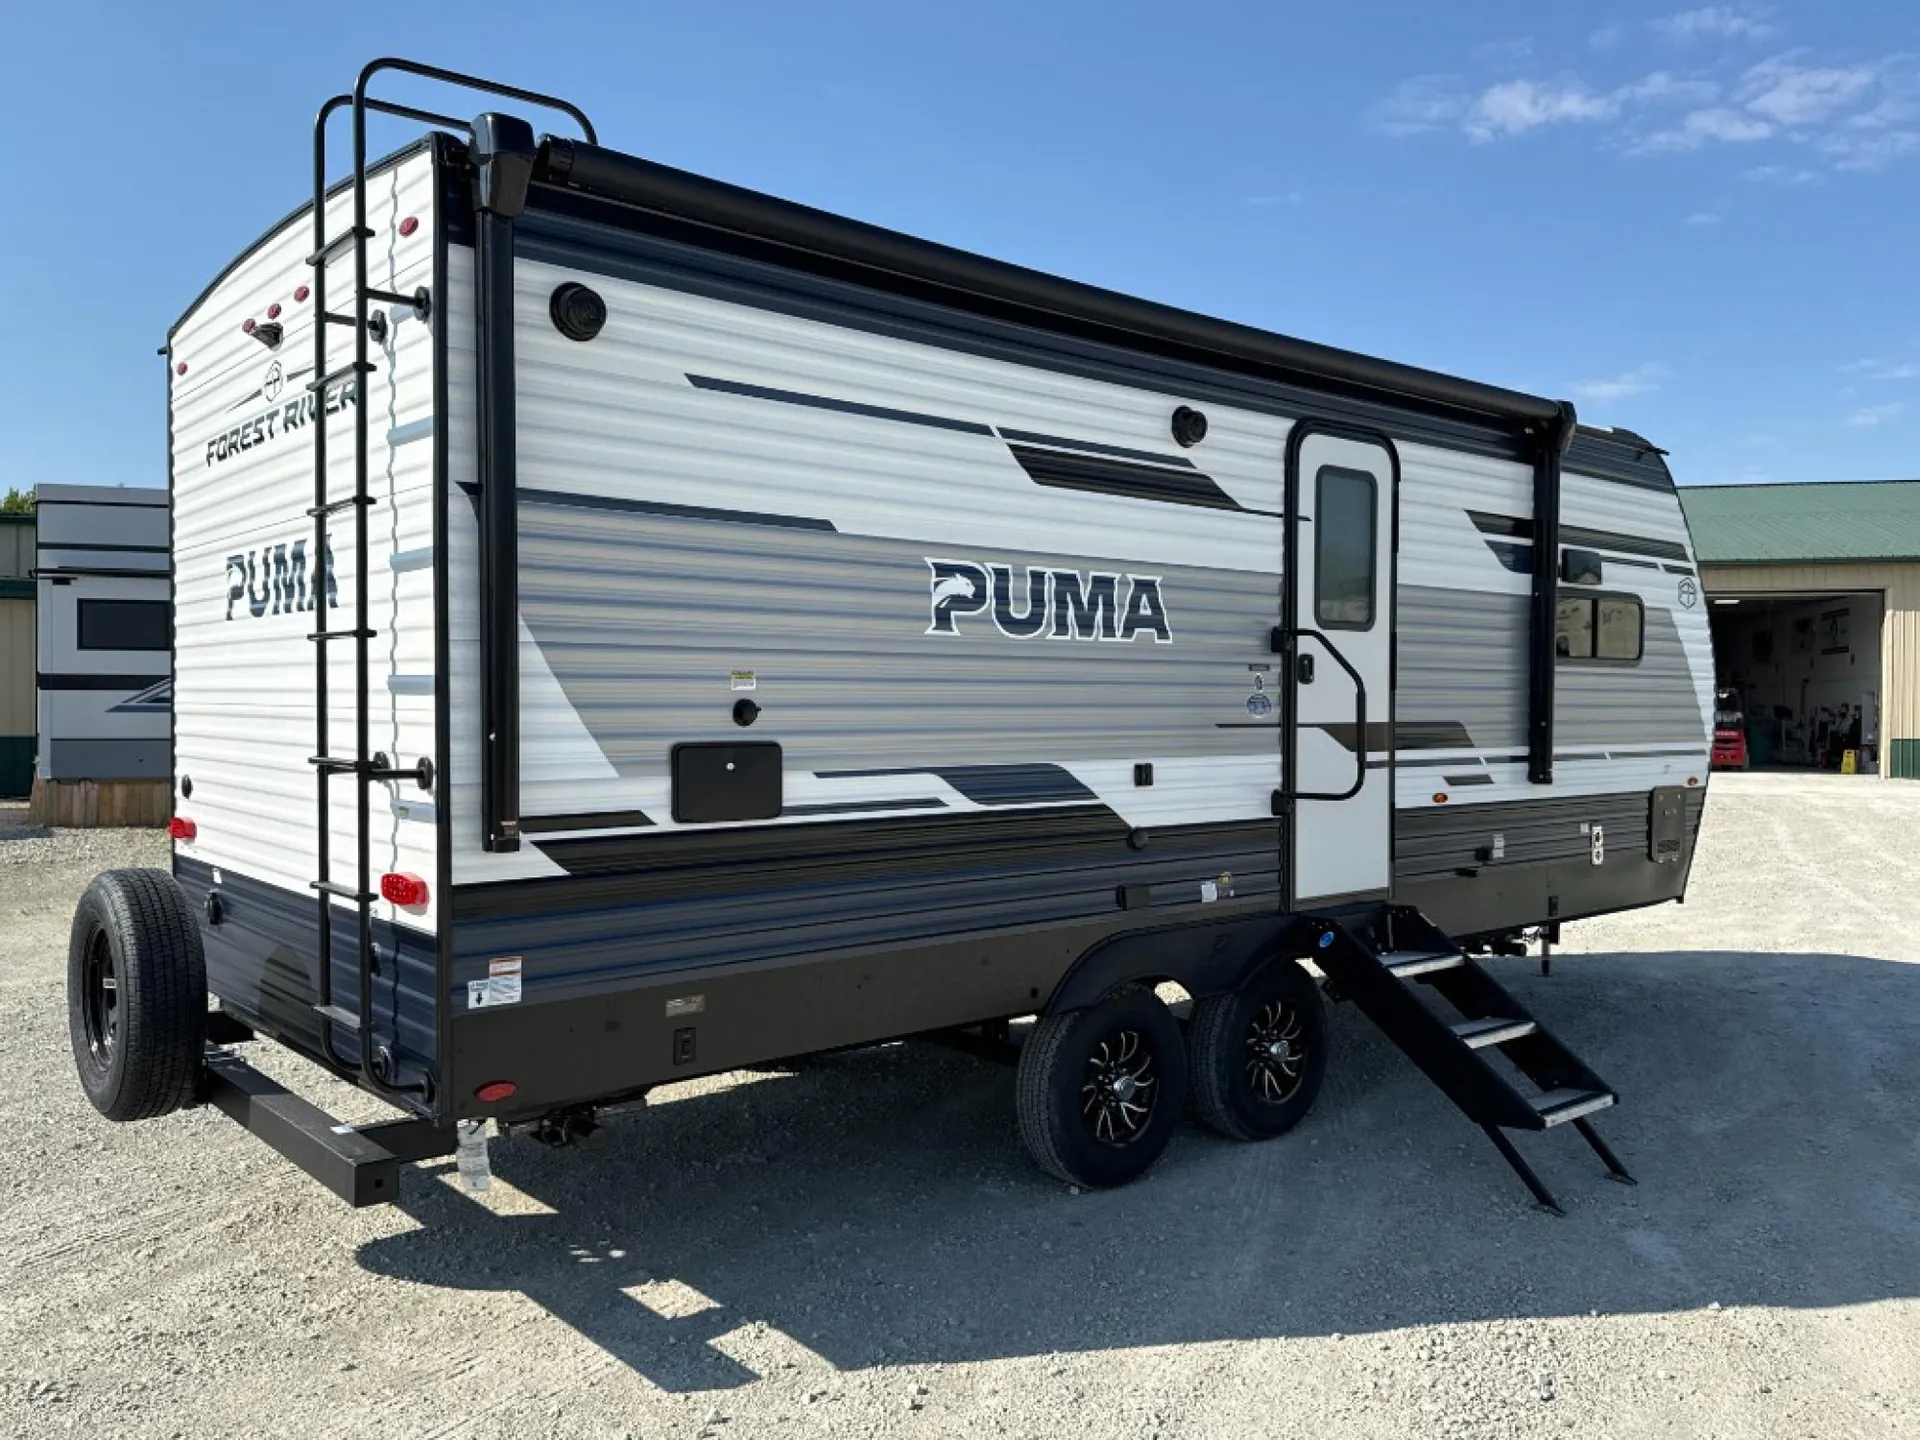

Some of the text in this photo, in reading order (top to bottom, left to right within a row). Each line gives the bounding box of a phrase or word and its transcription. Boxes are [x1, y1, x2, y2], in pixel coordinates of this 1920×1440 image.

[206, 409, 280, 467] FOREST
[226, 533, 339, 621] PUMA
[924, 557, 1173, 644] PUMA
